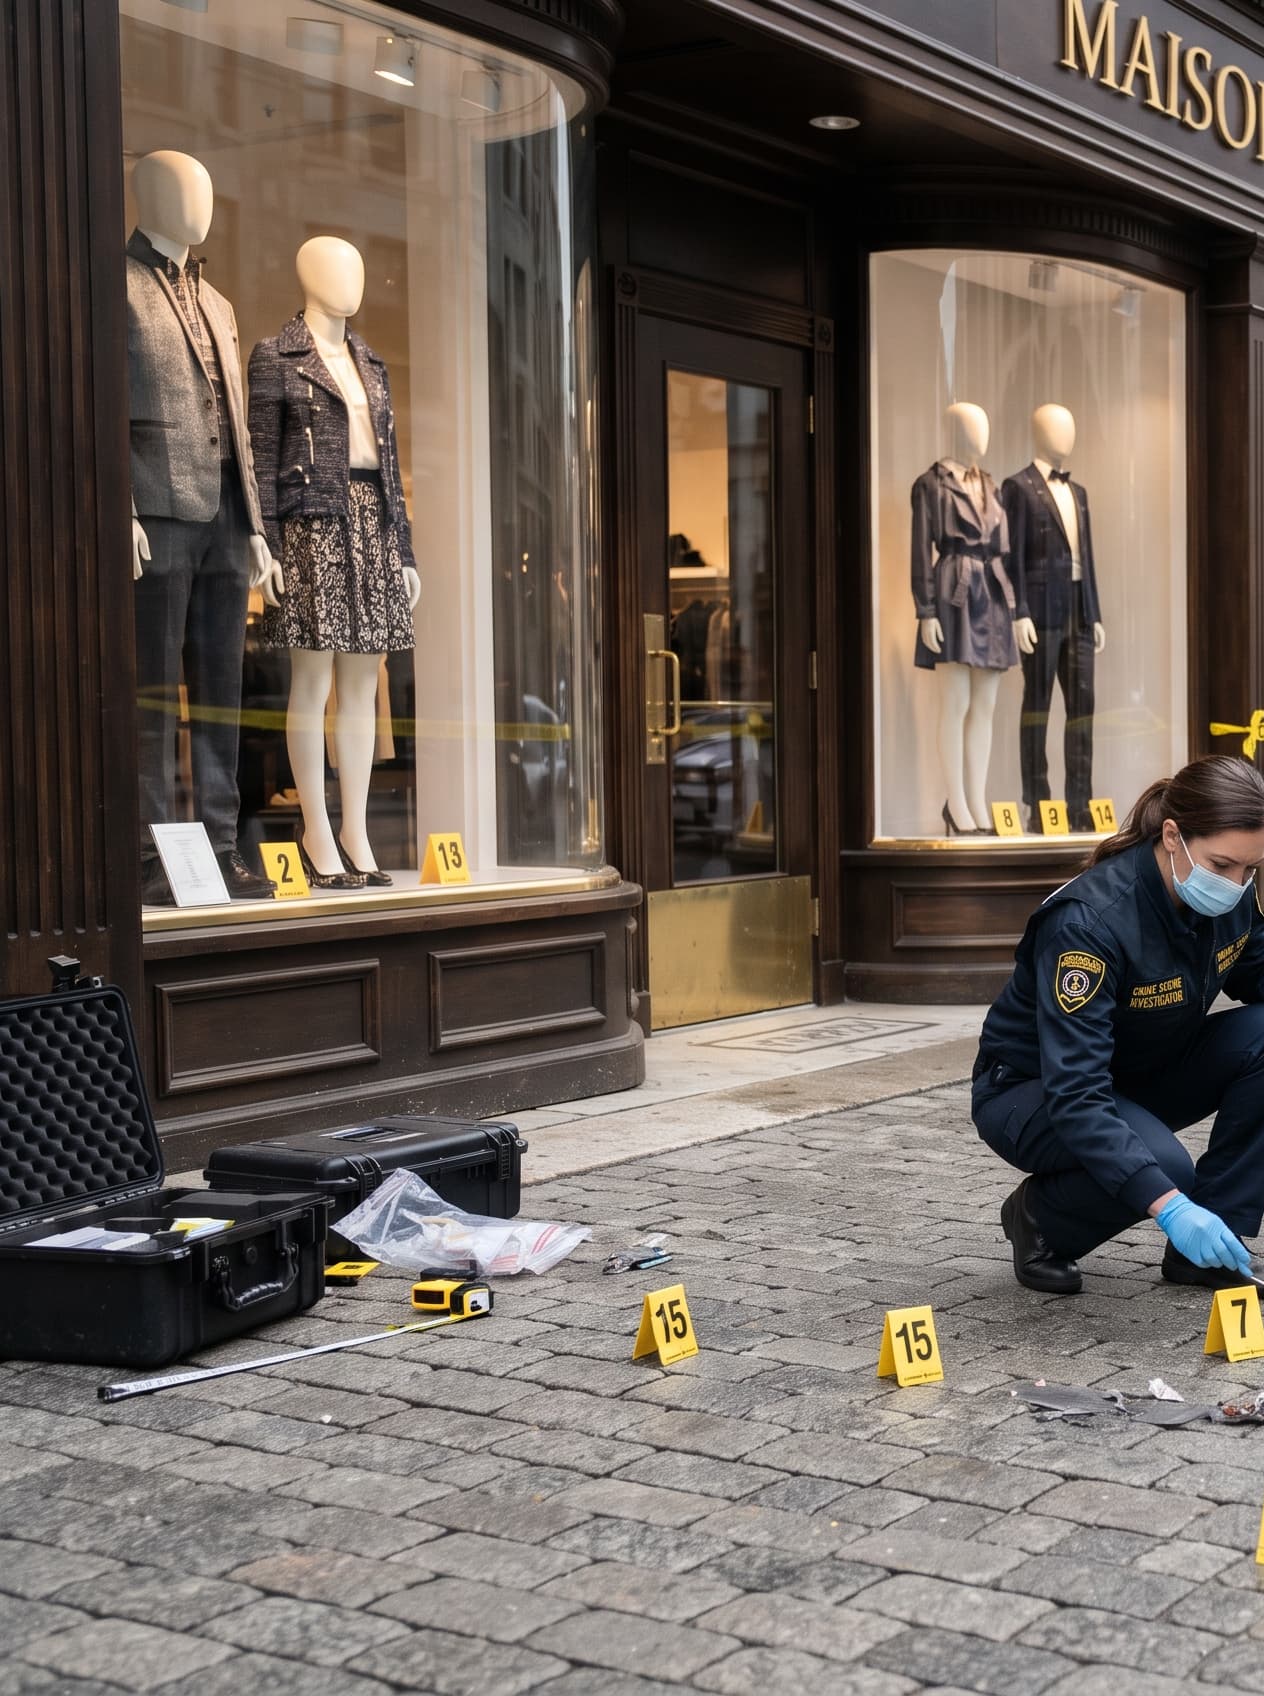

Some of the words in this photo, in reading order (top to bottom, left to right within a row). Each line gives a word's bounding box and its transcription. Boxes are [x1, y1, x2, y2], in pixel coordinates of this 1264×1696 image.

[1003, 809, 1014, 828] 8
[1096, 804, 1113, 826] 14
[277, 853, 294, 884] 2
[437, 841, 463, 871] 13
[655, 1298, 688, 1344] 15
[1230, 1298, 1247, 1339] 7
[895, 1319, 933, 1364] 15
